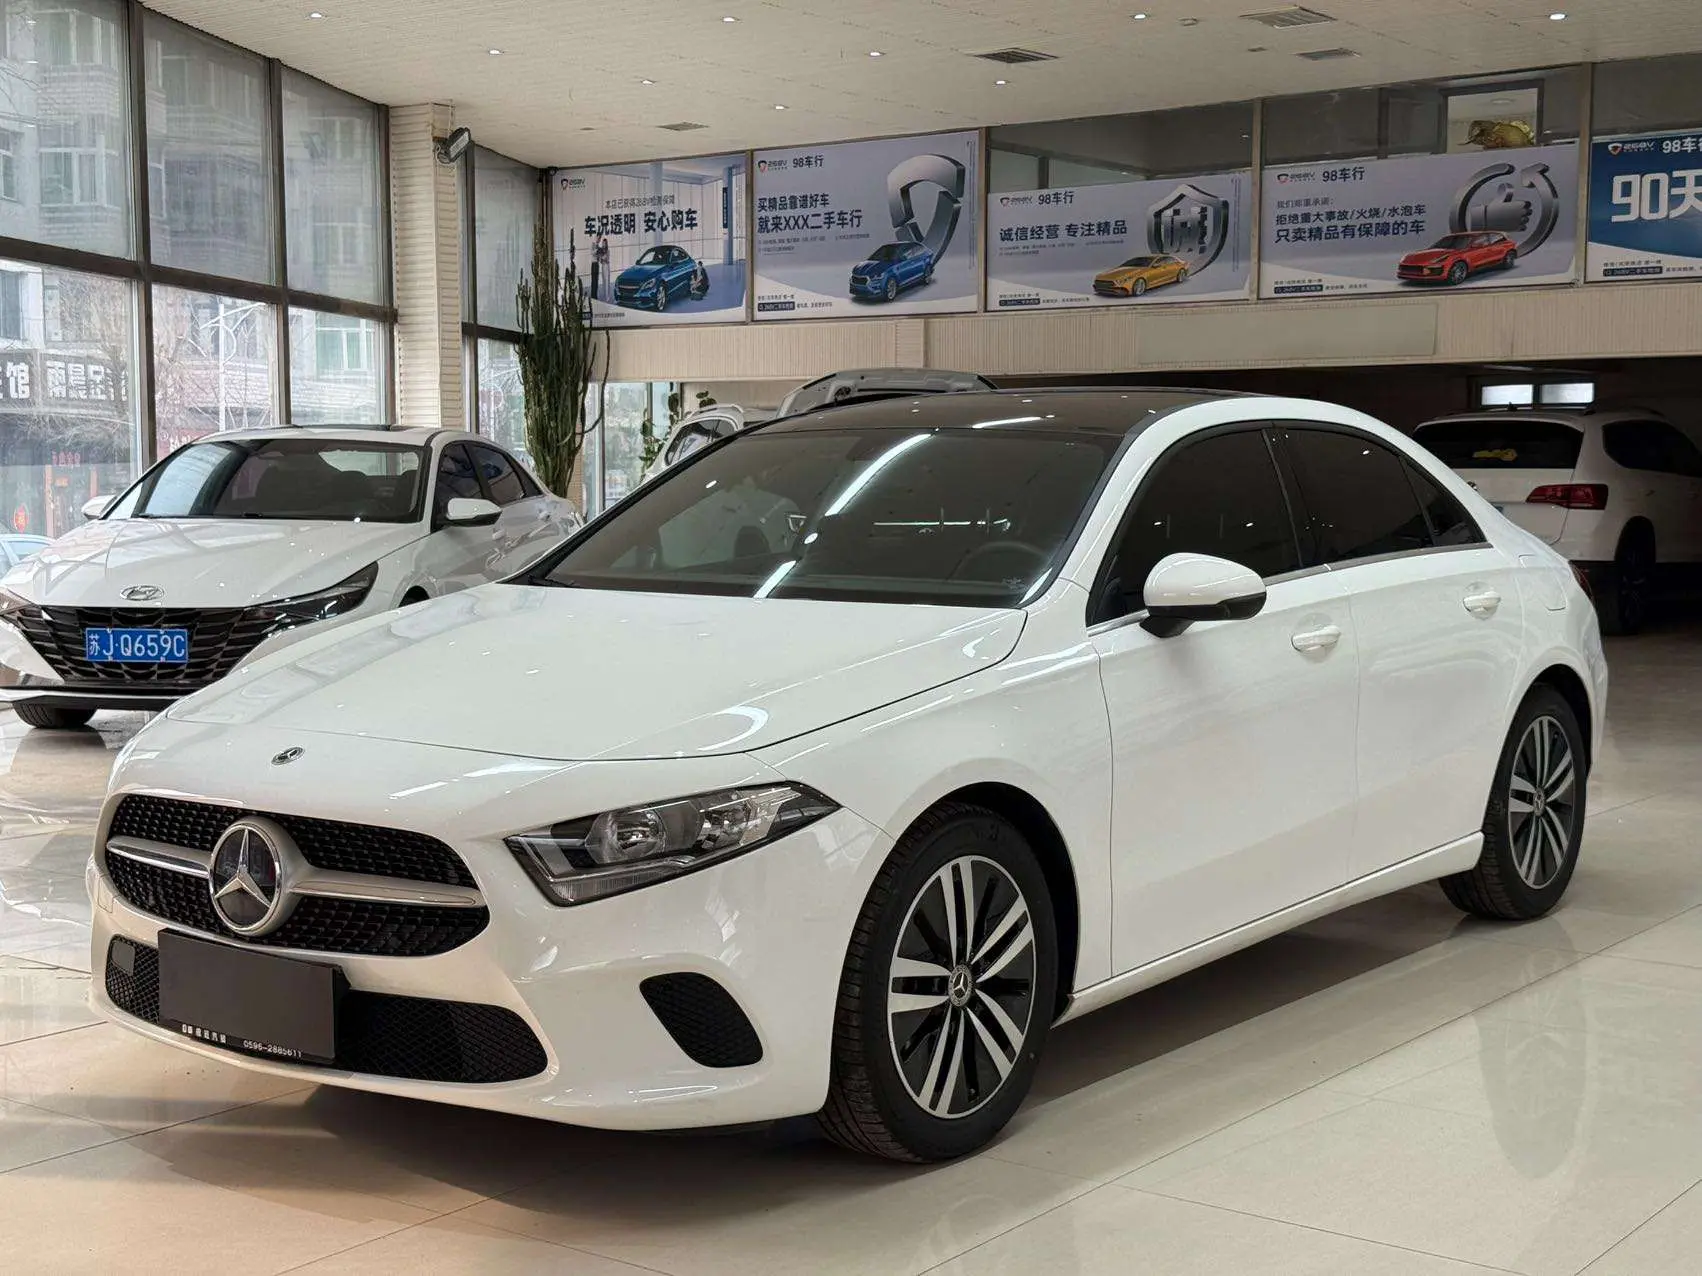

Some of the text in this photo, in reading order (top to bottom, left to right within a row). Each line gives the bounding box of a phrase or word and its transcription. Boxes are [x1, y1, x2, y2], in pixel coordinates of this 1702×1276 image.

[792, 155, 824, 169] 98车行
[1322, 166, 1365, 182] 98车行
[758, 193, 830, 212] 买精品靠谱好车
[1038, 191, 1074, 205] 98车行
[584, 208, 698, 237] 车况透明 安心购车
[757, 209, 863, 234] 就来XXX二手车行
[1275, 204, 1427, 226] 拒绝重大事故/火烧/水泡车
[999, 219, 1128, 242] 诚信经营 专注精品
[1274, 219, 1426, 244] 只卖精品有保障的车
[0, 361, 30, 400] 馆
